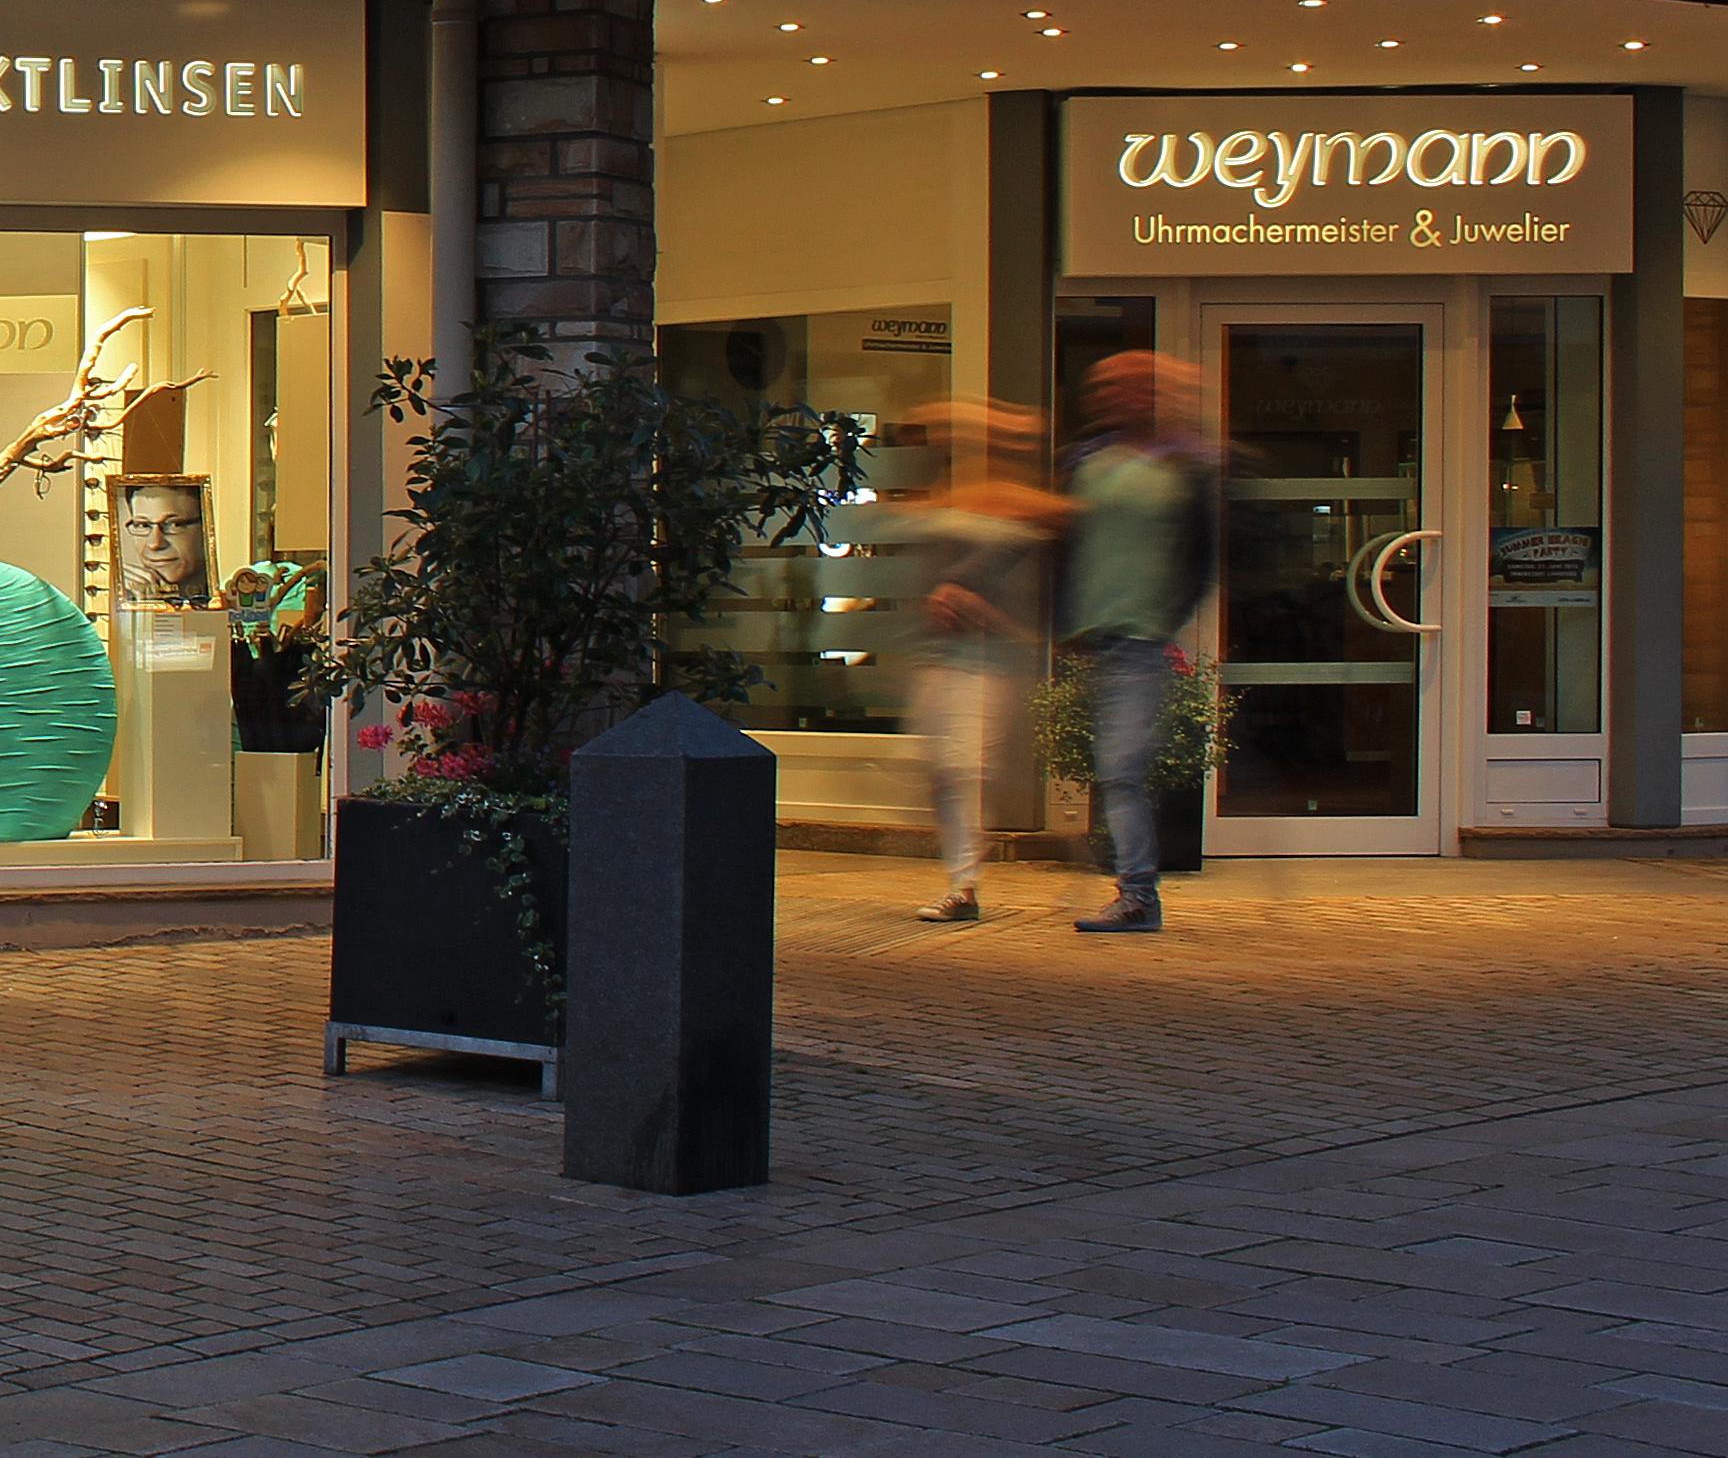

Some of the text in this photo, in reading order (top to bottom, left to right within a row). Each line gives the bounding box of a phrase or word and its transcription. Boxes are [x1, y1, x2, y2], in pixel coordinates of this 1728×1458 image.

[1118, 129, 1587, 209] weymann
[1134, 209, 1570, 248] Uhrmachermeister & Juwelier
[871, 319, 947, 337] weymann
